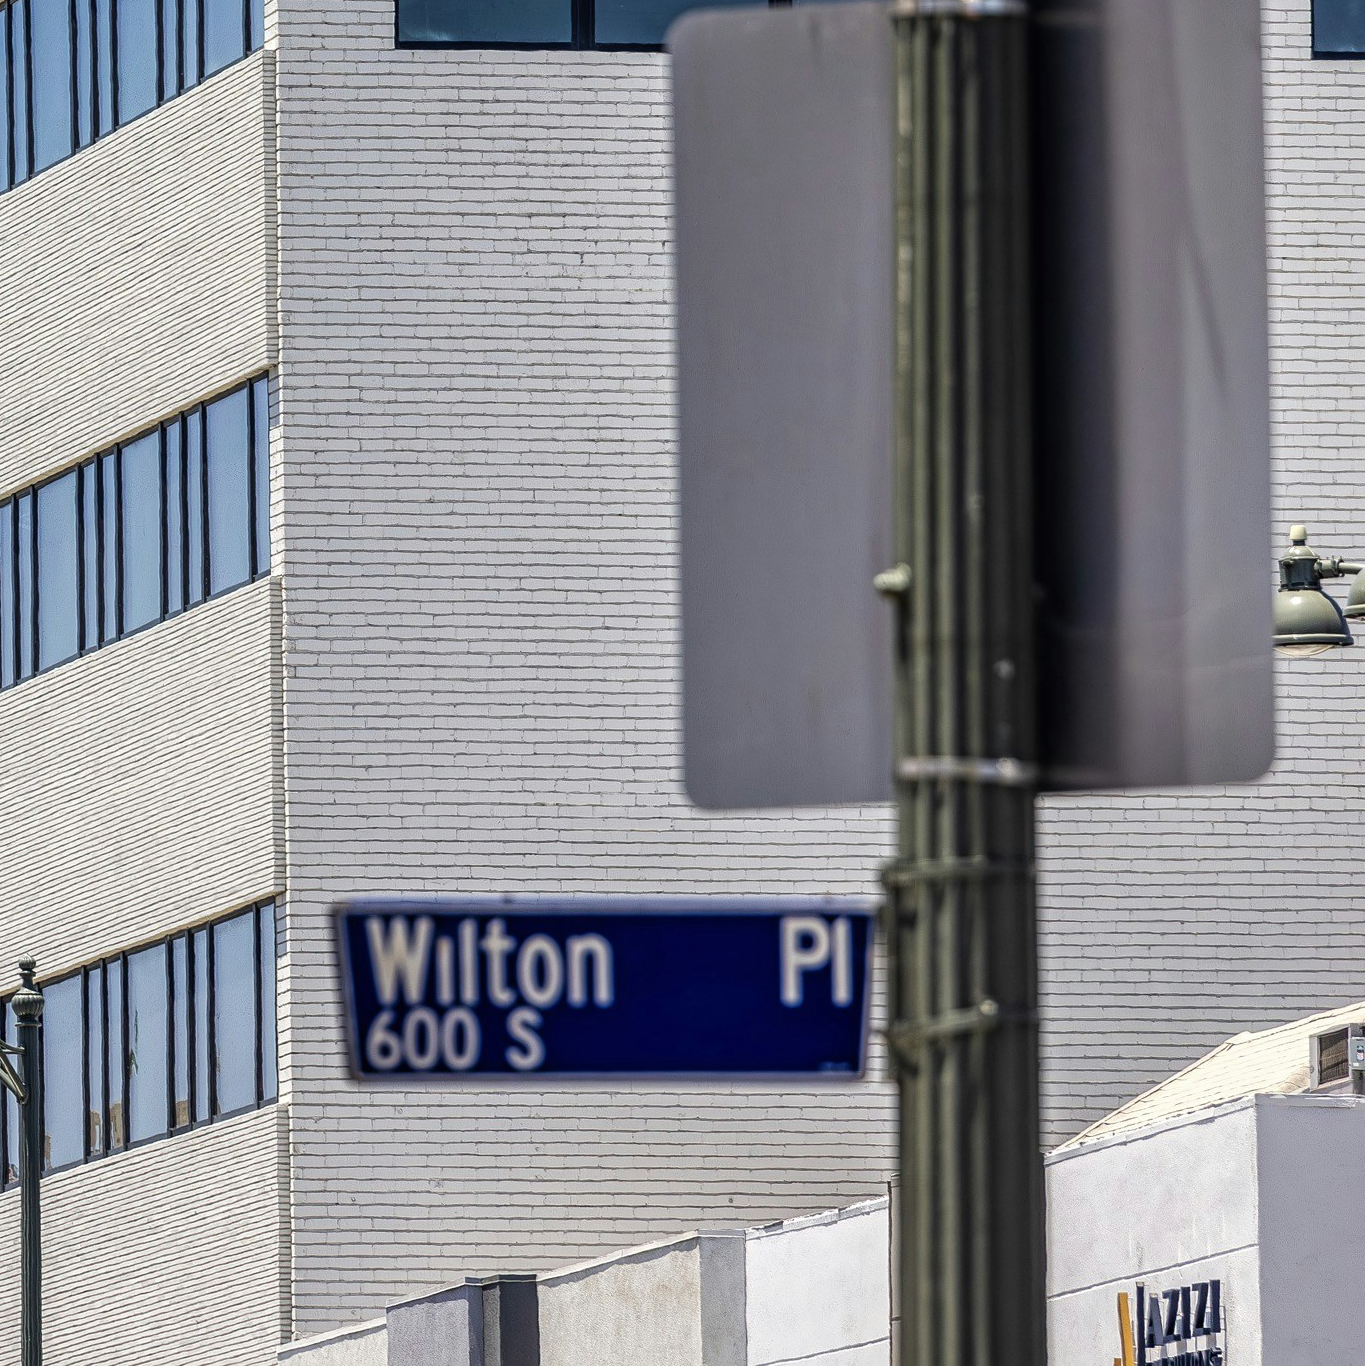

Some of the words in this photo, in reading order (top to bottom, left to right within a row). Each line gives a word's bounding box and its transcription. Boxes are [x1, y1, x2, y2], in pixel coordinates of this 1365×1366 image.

[365, 915, 614, 1009] Wilton
[778, 915, 854, 1008] Pl
[365, 1009, 481, 1072] 600
[505, 1007, 545, 1072] S
